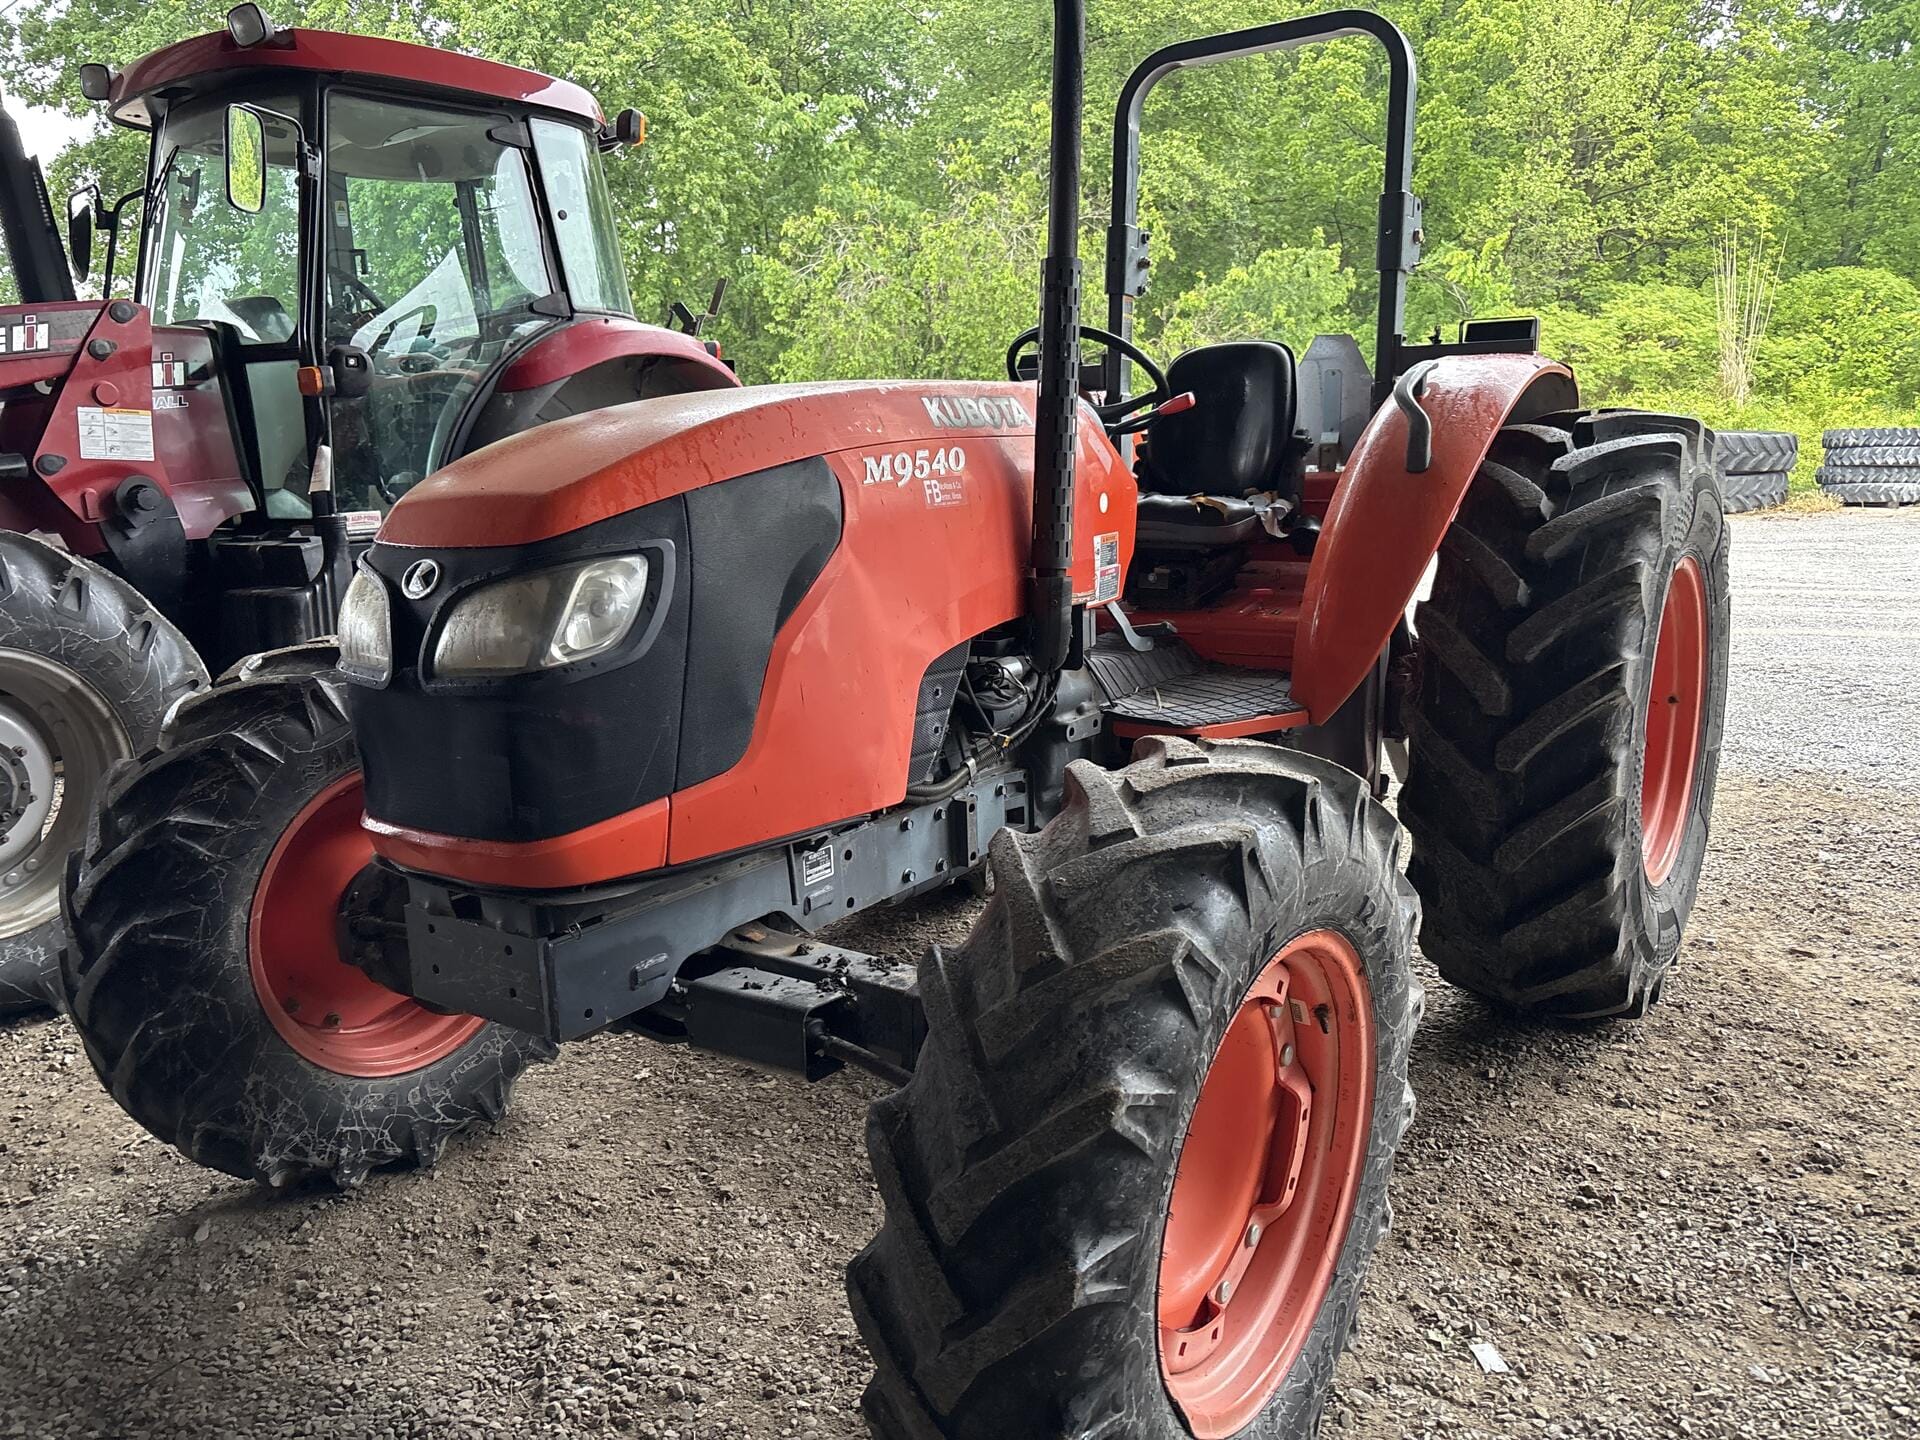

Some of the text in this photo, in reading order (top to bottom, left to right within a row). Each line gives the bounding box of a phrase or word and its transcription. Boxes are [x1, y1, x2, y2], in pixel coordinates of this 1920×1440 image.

[152, 394, 189, 410] ALL
[920, 395, 1033, 429] KUBOTA
[862, 446, 966, 488] M9540
